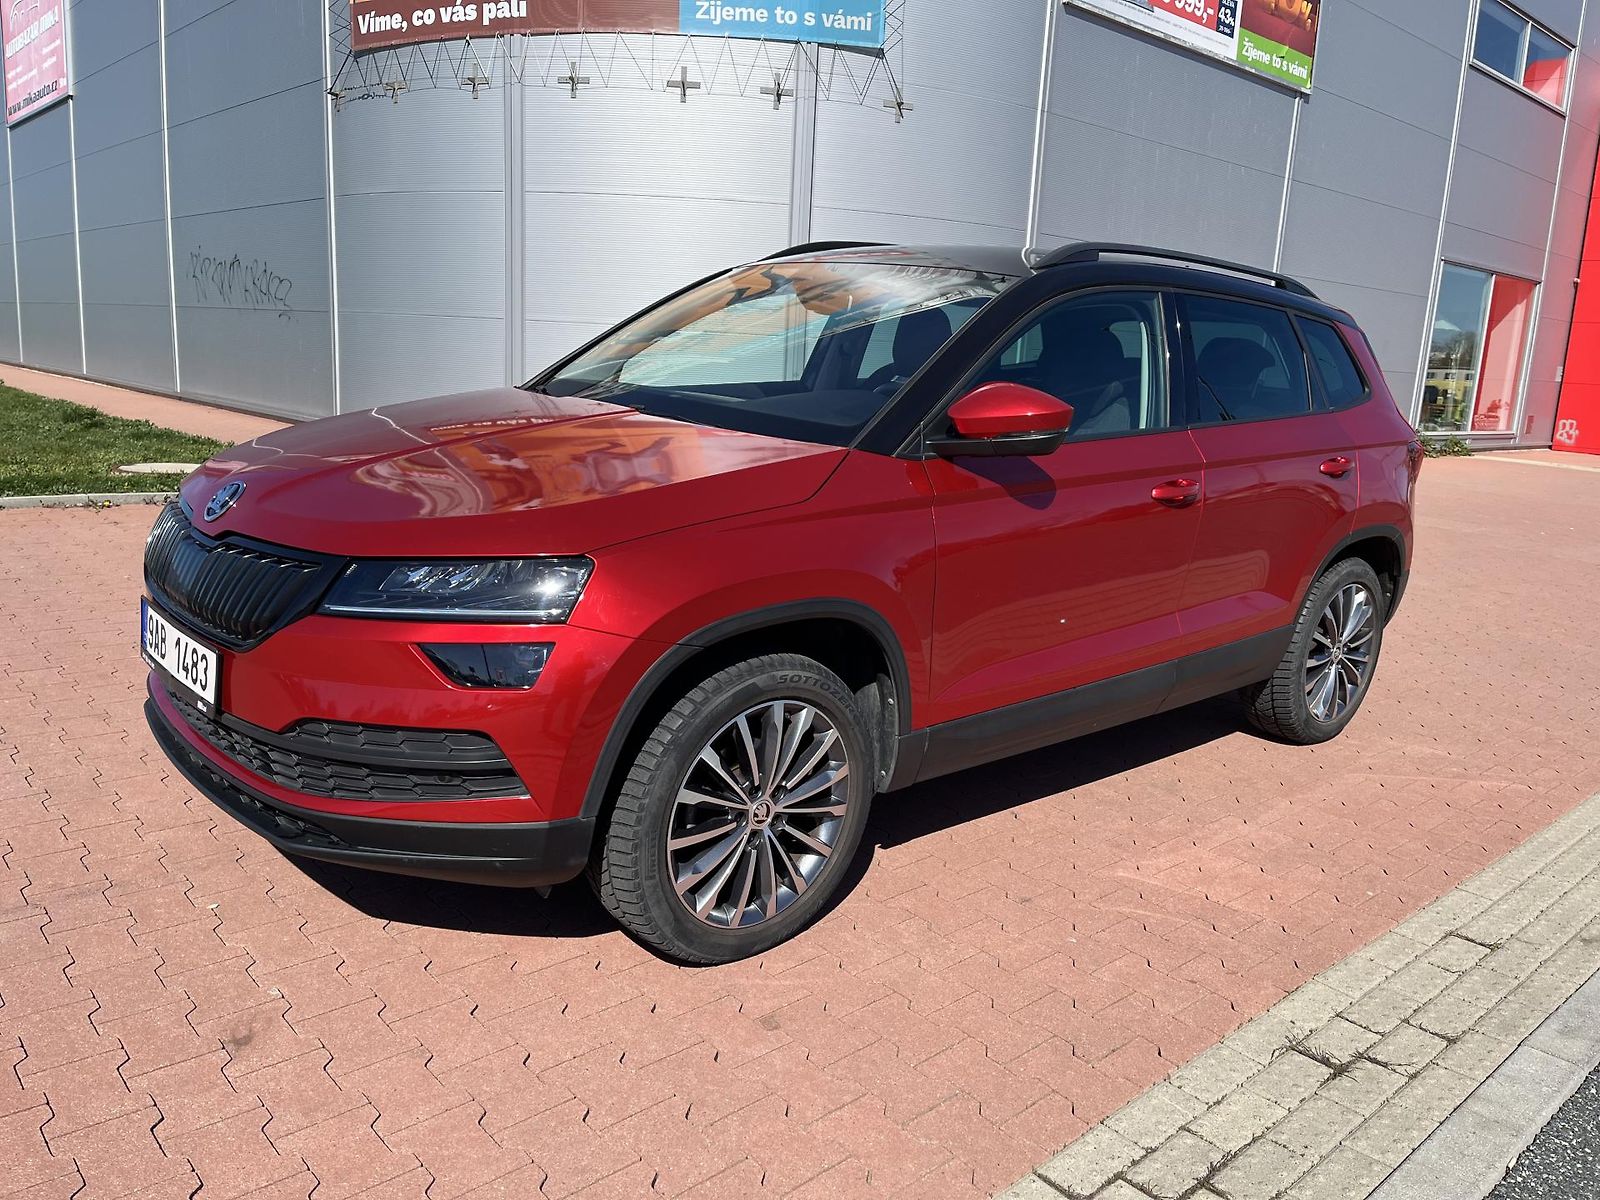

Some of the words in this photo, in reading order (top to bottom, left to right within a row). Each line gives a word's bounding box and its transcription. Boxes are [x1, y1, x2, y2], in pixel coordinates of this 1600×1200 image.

[357, 10, 408, 35] Víme,
[412, 8, 436, 27] co
[439, 0, 478, 23] vás
[774, 6, 798, 25] to
[803, 11, 816, 26] s
[821, 9, 873, 31] vámi
[1218, 6, 1235, 27] 43%
[1241, 37, 1271, 65] Žijeme
[1272, 54, 1282, 69] to
[1282, 60, 1288, 72] s
[1288, 61, 1308, 80] vámi
[7, 80, 58, 116] www.mikaauto.cz
[148, 614, 166, 660] 9AB
[175, 637, 209, 692] 1483
